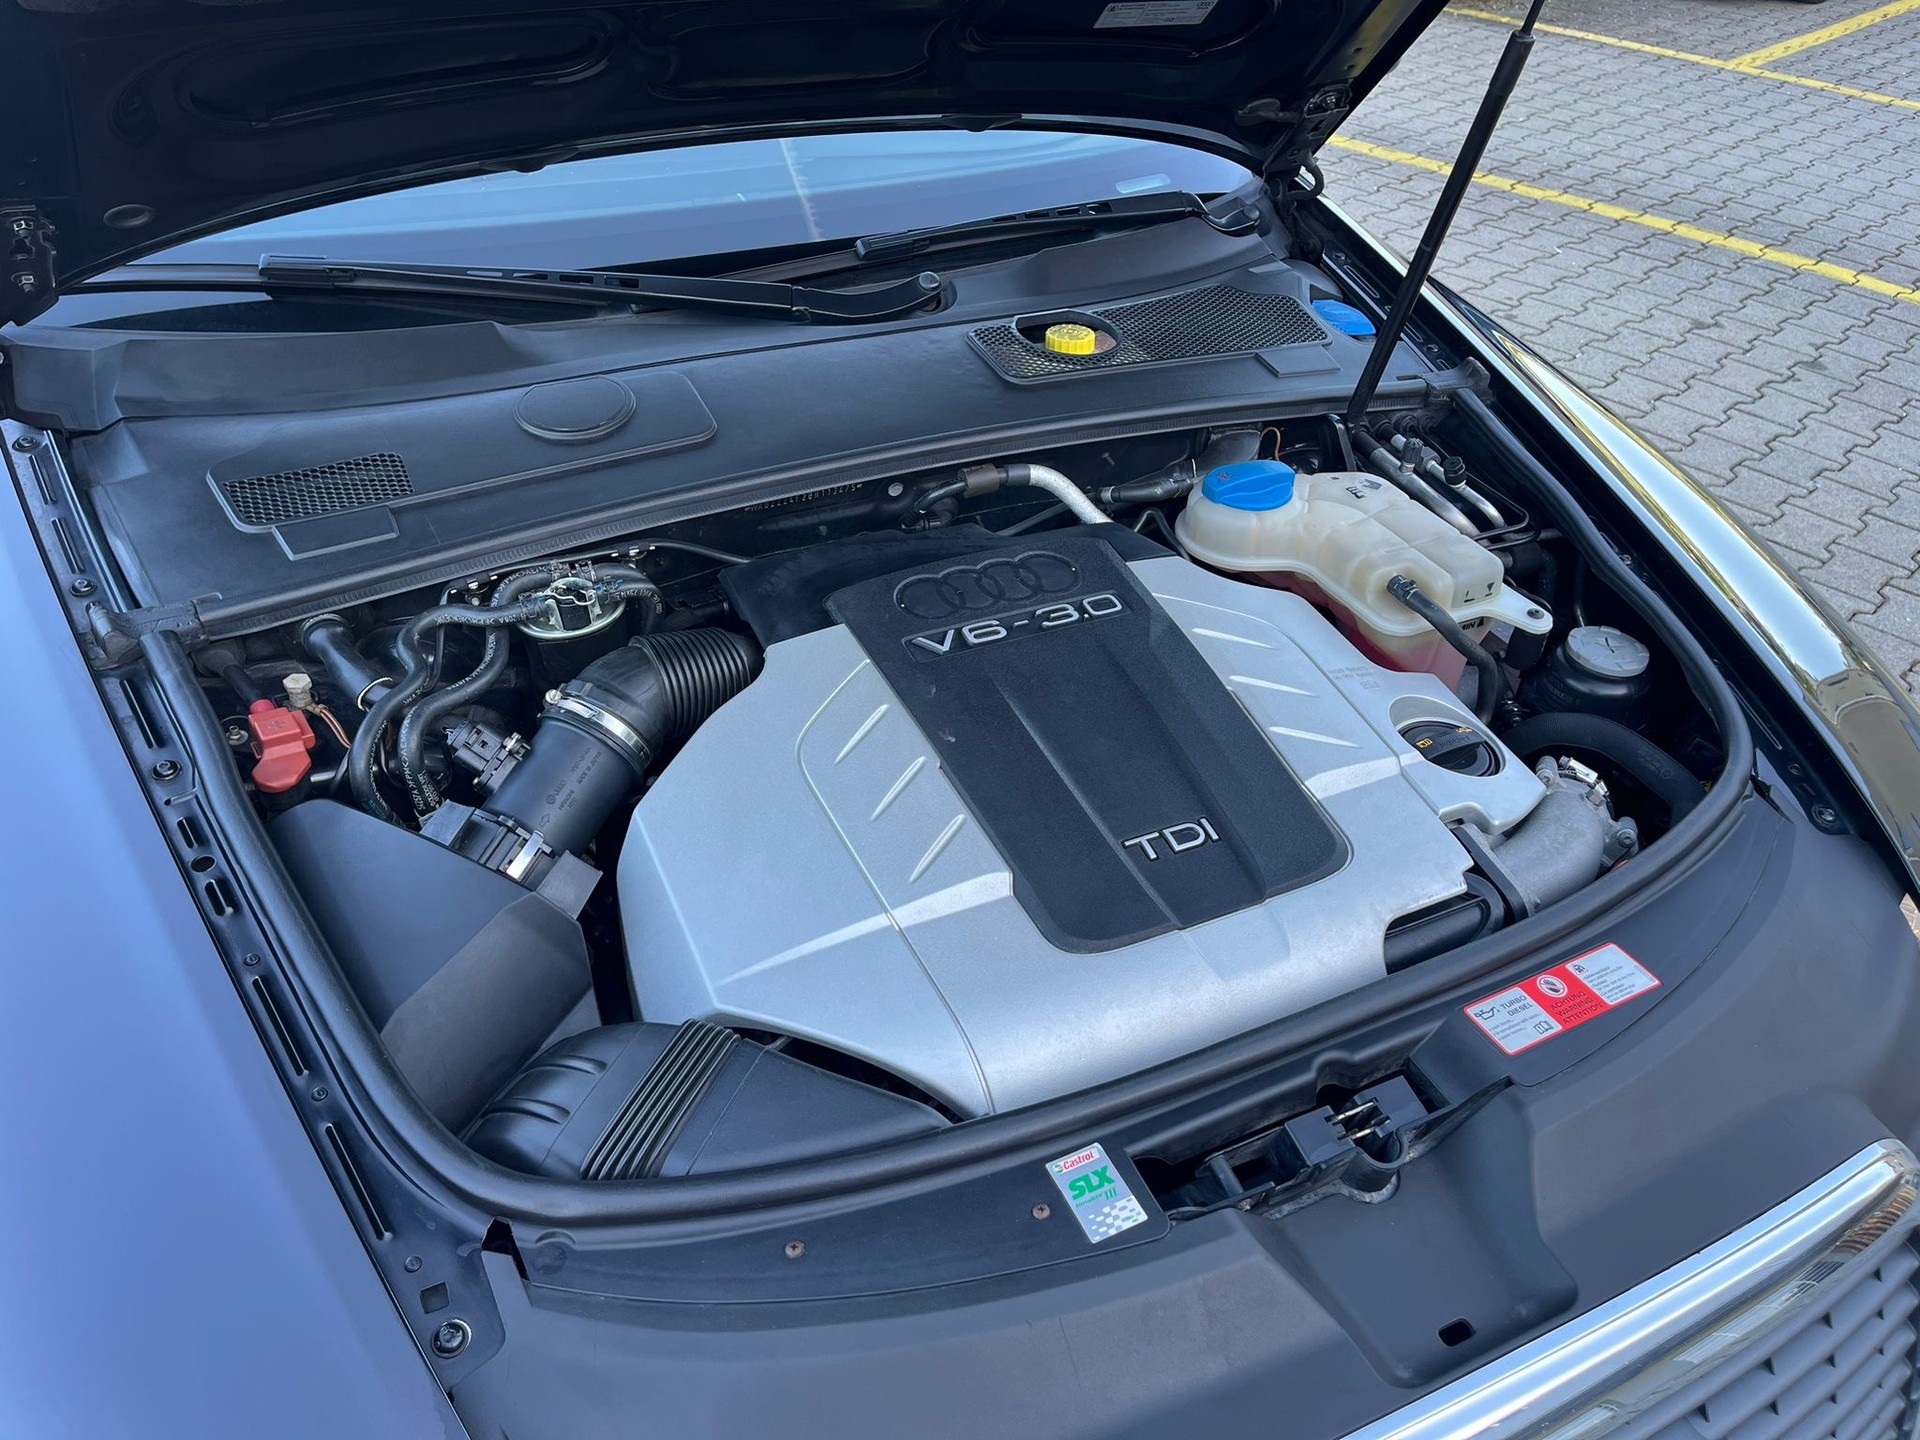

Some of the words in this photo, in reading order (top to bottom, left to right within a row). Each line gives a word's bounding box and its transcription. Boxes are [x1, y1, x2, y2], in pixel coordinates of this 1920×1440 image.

[1121, 817, 1220, 860] TDI
[1500, 994, 1527, 1011] TURBO
[1509, 1003, 1534, 1018] DIESEL
[1550, 992, 1586, 1011] ACHTUNG
[1556, 997, 1594, 1018] WARNING
[1562, 1004, 1603, 1025] ATTENTION
[1063, 1151, 1094, 1170] Castrol
[1068, 1165, 1116, 1201] SLX
